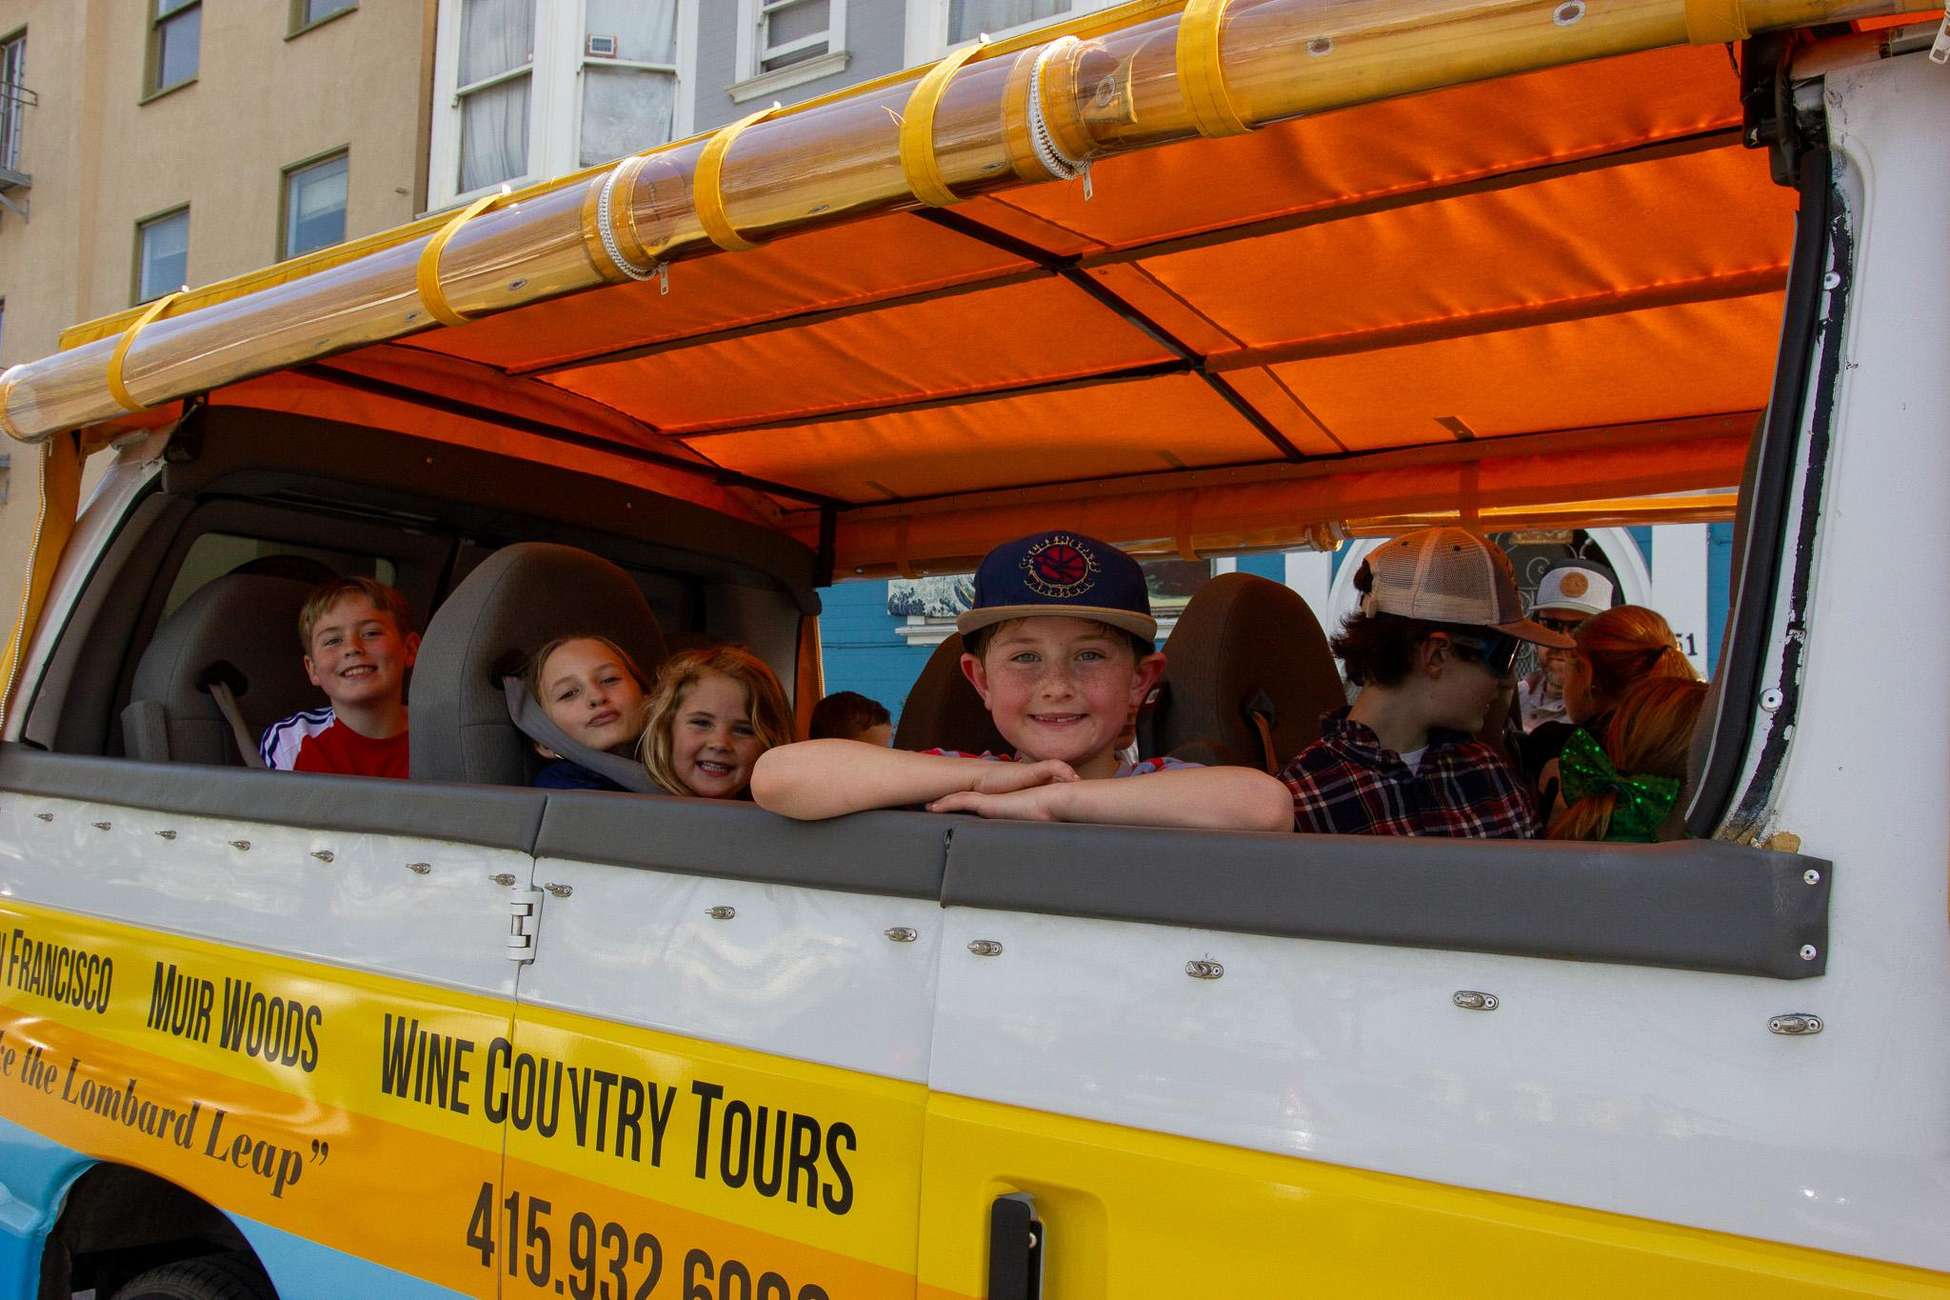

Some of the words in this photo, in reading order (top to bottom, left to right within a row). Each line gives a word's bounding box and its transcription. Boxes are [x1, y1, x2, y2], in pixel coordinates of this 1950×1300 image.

[7, 928, 113, 1014] FRANCISCO
[147, 961, 215, 1043] MUIR
[219, 976, 322, 1073] WOODS
[20, 1046, 58, 1095] the
[62, 1057, 201, 1150] Lombard
[381, 1012, 475, 1115] WINE
[692, 1079, 857, 1216] TOURS
